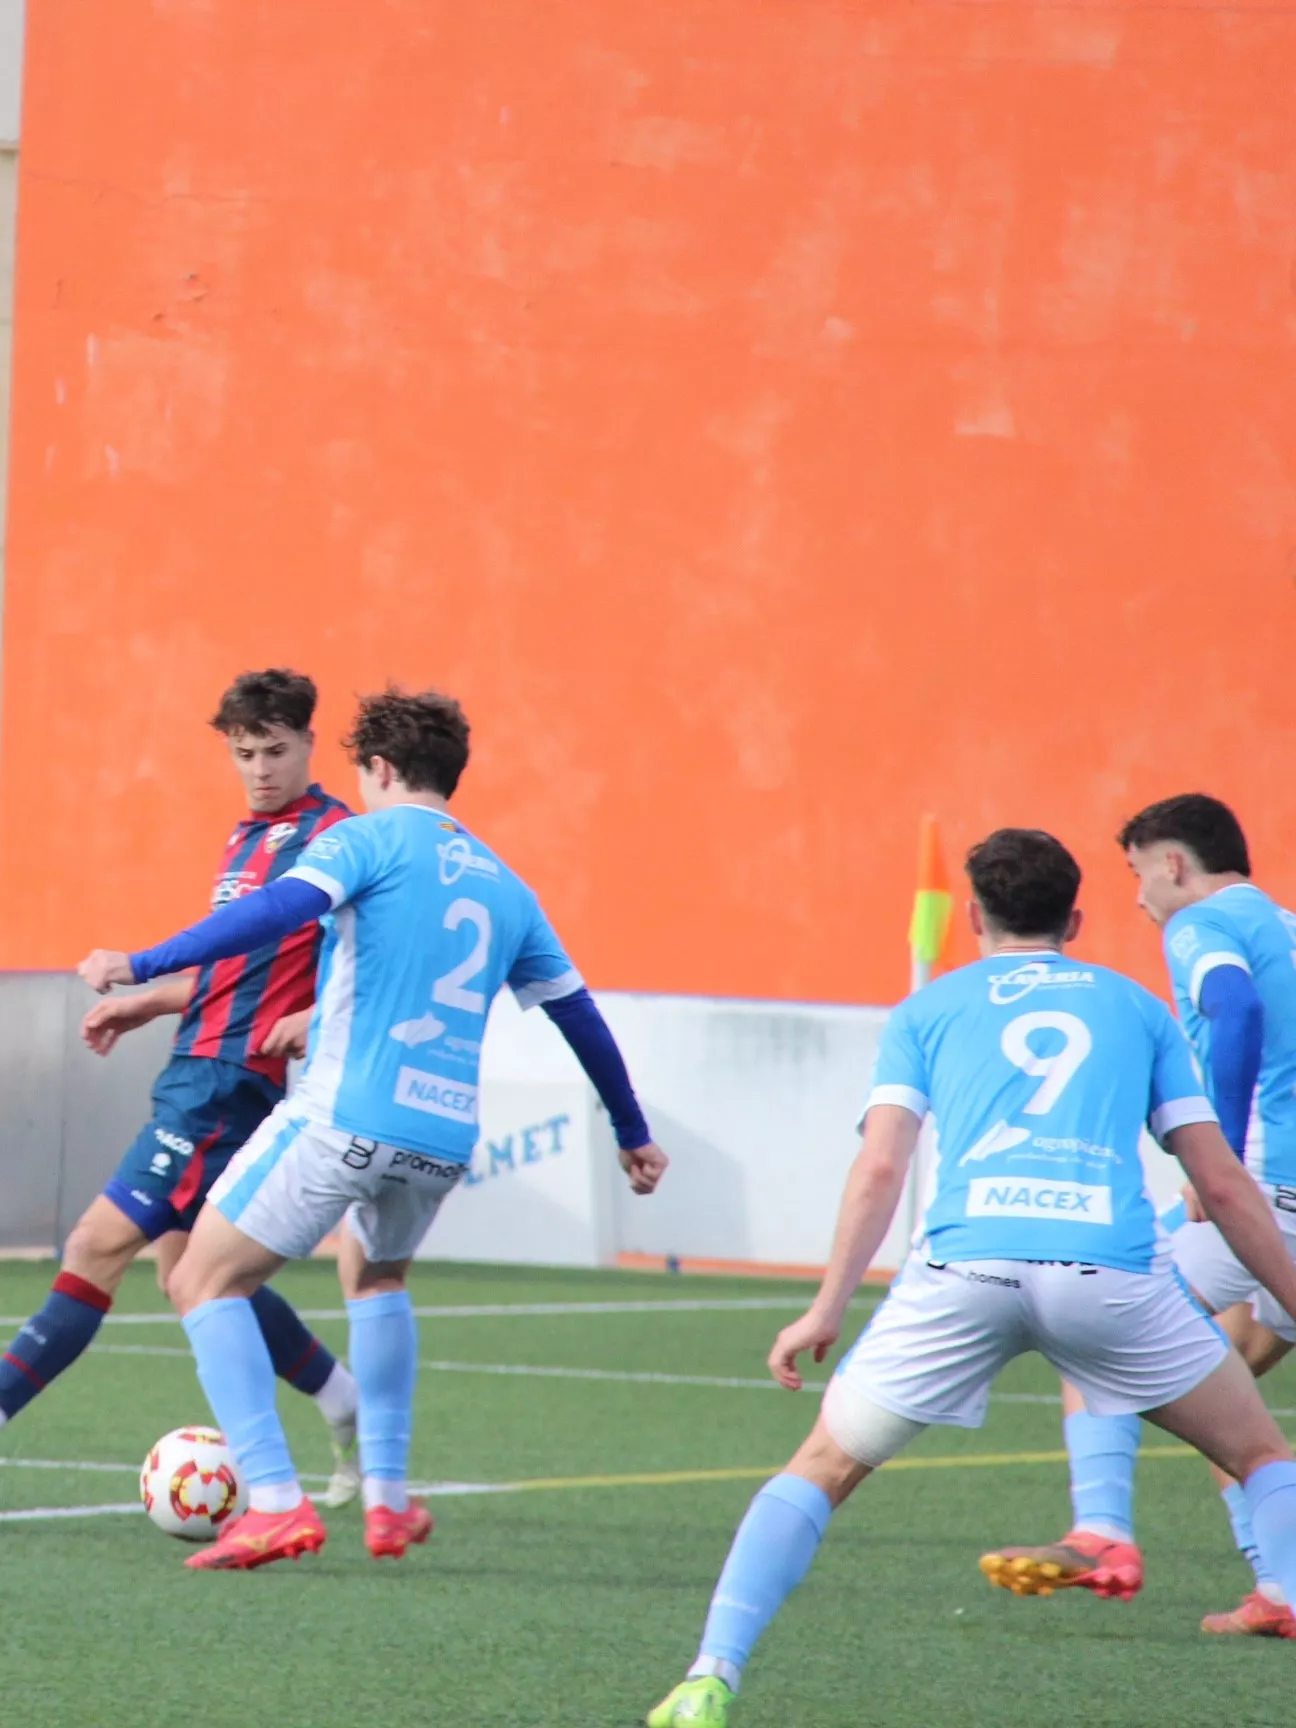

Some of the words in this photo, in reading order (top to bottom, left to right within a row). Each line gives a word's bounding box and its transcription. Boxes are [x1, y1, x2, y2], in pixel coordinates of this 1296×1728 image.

[432, 898, 491, 1014] 2
[1001, 1010, 1091, 1115] 9
[984, 1186, 1093, 1213] NACEX
